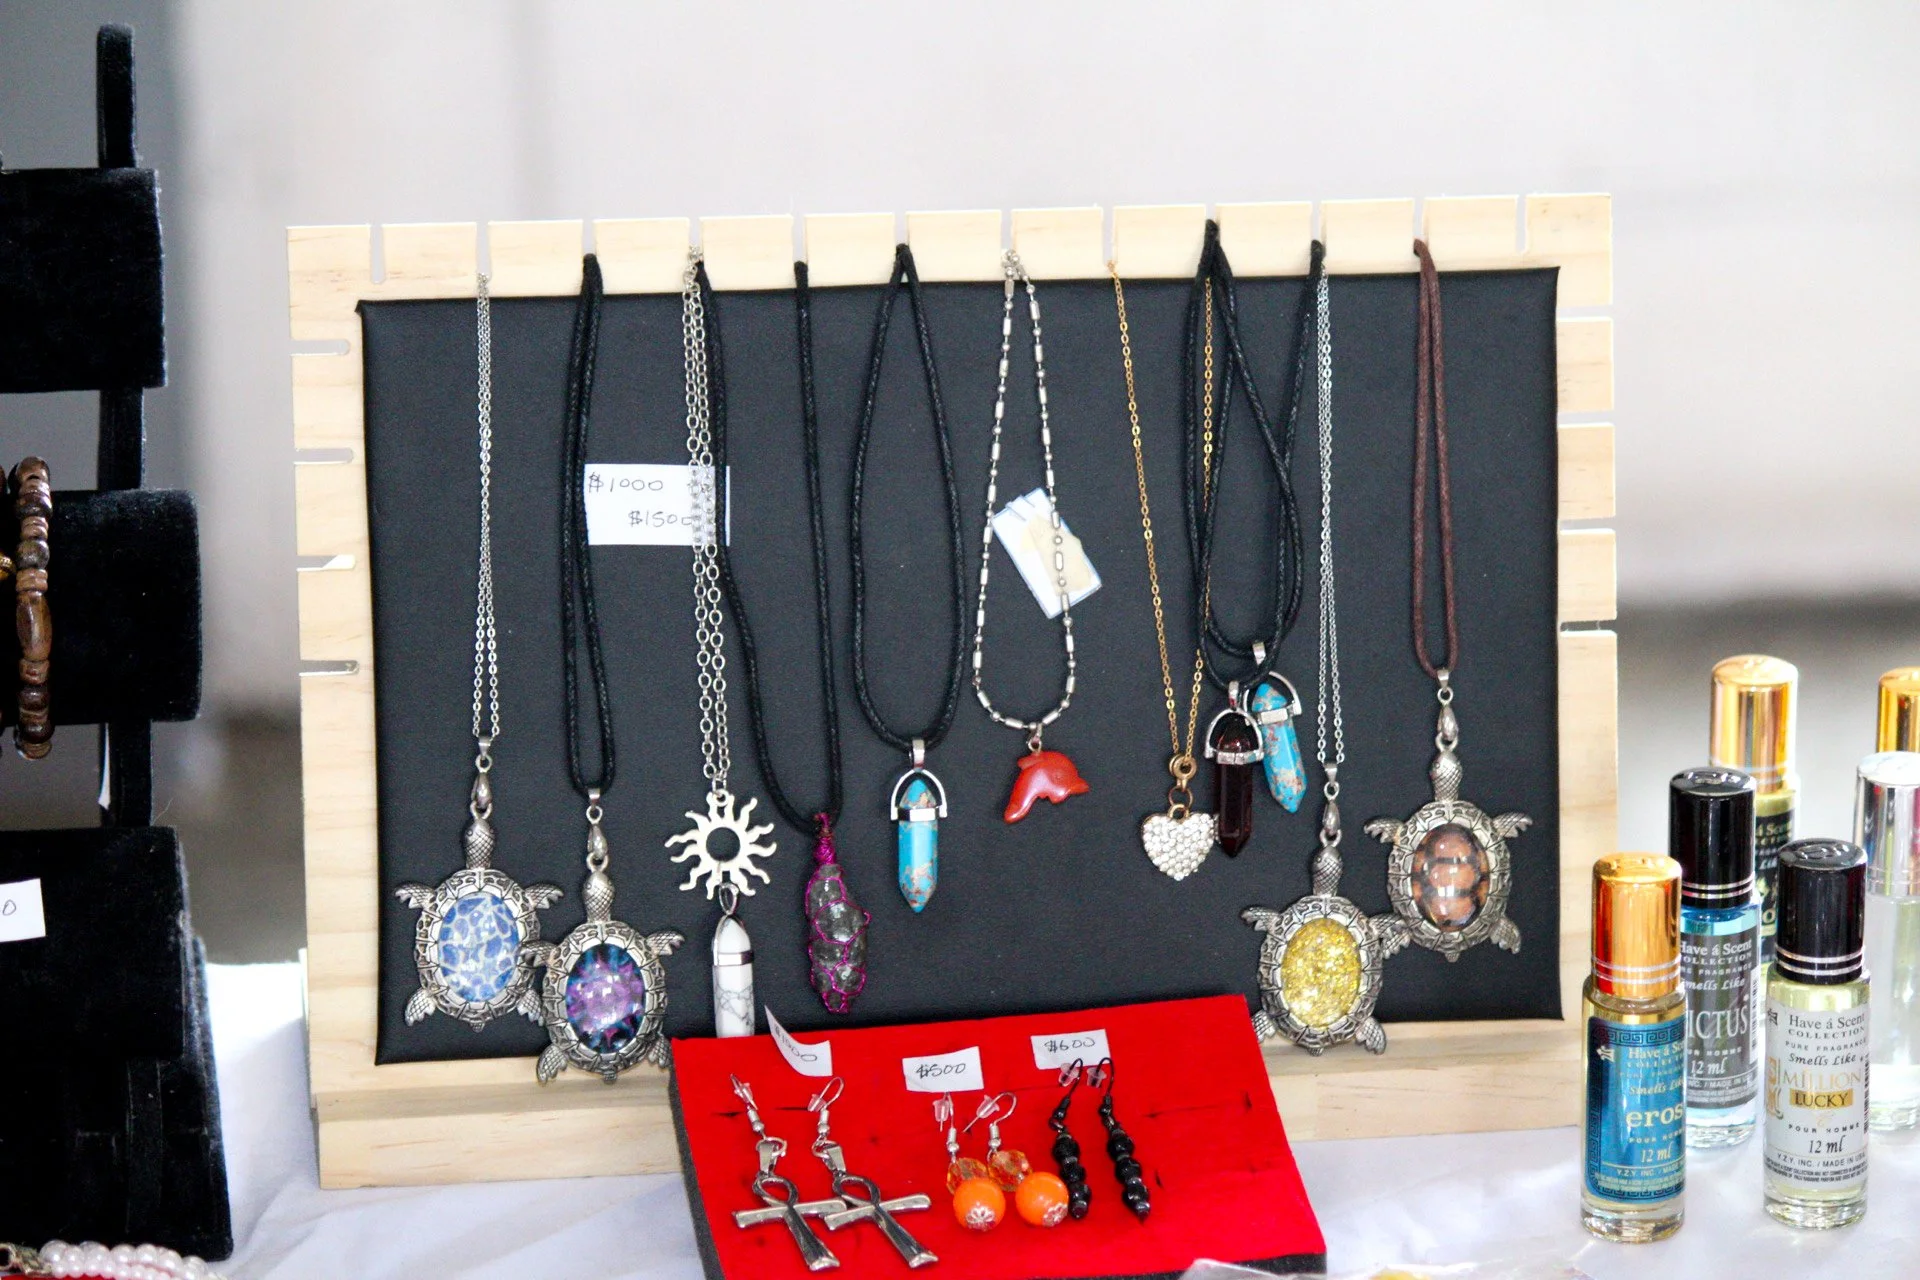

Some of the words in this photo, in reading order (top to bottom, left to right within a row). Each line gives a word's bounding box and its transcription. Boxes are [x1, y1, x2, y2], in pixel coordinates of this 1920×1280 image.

[588, 472, 664, 493] $1000
[1722, 939, 1752, 955] Scent
[1721, 977, 1745, 990] Like
[1687, 1004, 1748, 1039] ICTUS
[1789, 1014, 1822, 1029] Have
[1837, 1013, 1865, 1029] Scent
[1788, 1026, 1865, 1039] COLLECTION
[1691, 1060, 1704, 1075] 12
[1707, 1057, 1728, 1075] ml
[1789, 1053, 1828, 1066] Smells
[1832, 1053, 1856, 1066] Like
[1795, 1092, 1849, 1107] LUCKY
[1626, 1103, 1684, 1128] eros
[1641, 1149, 1654, 1163] 12
[1657, 1141, 1674, 1161] ml
[1809, 1140, 1822, 1153] 12
[1826, 1135, 1846, 1153] ml
